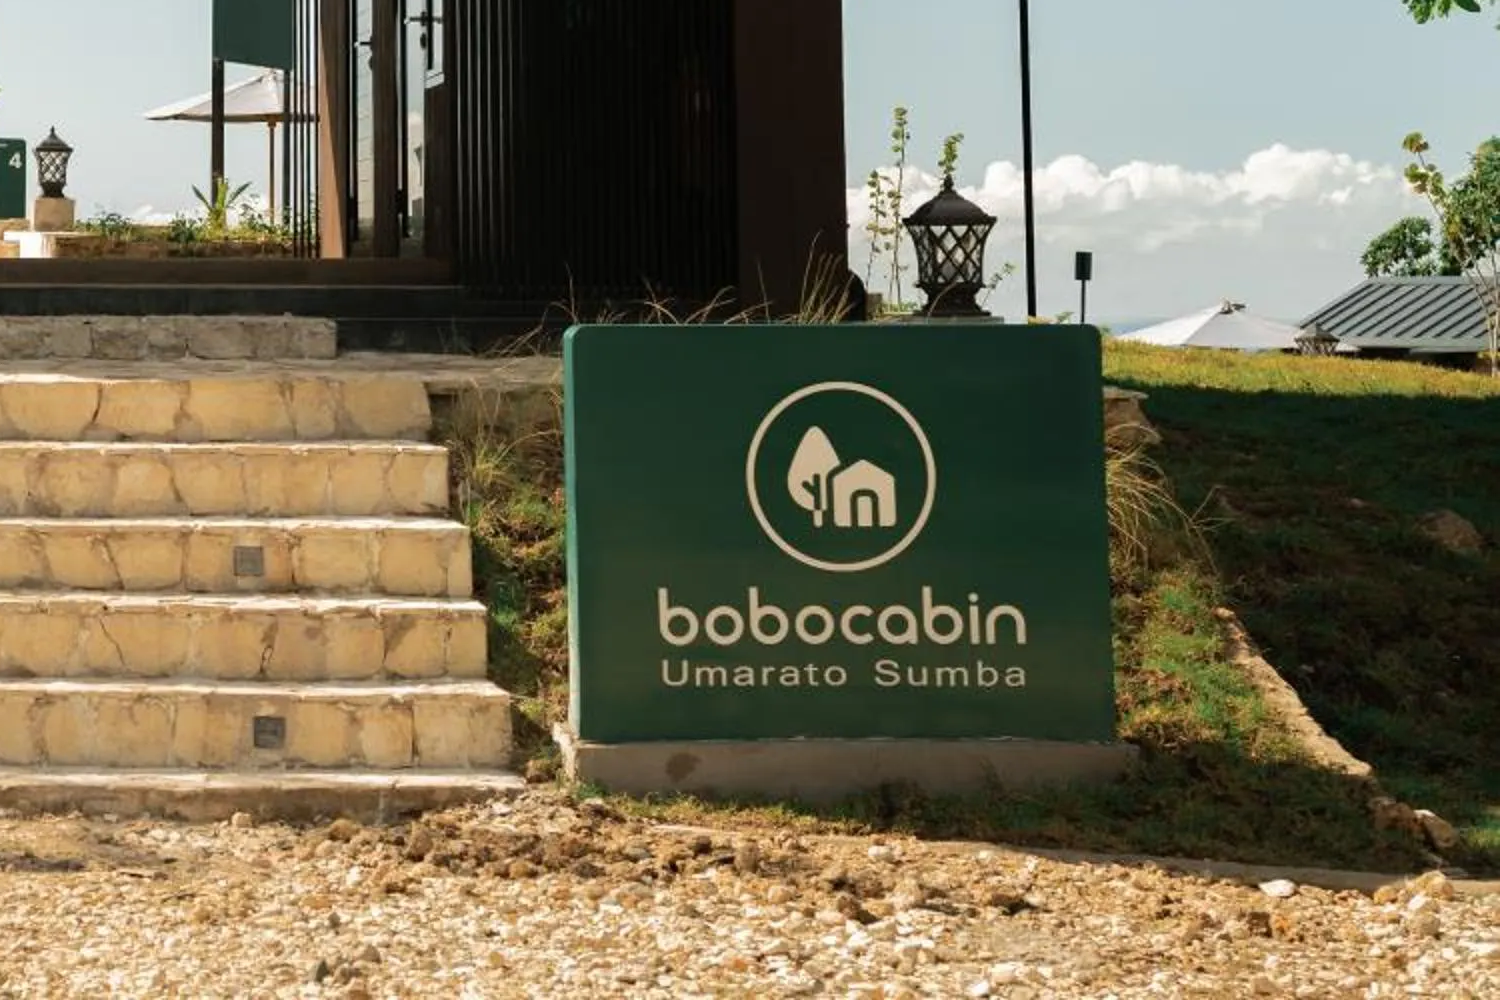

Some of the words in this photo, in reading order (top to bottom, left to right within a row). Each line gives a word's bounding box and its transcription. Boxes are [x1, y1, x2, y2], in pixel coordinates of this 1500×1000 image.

[8, 152, 23, 169] 4
[657, 586, 1027, 646] bobocabin
[661, 659, 848, 687] Umarato
[874, 659, 1026, 687] Sumba
